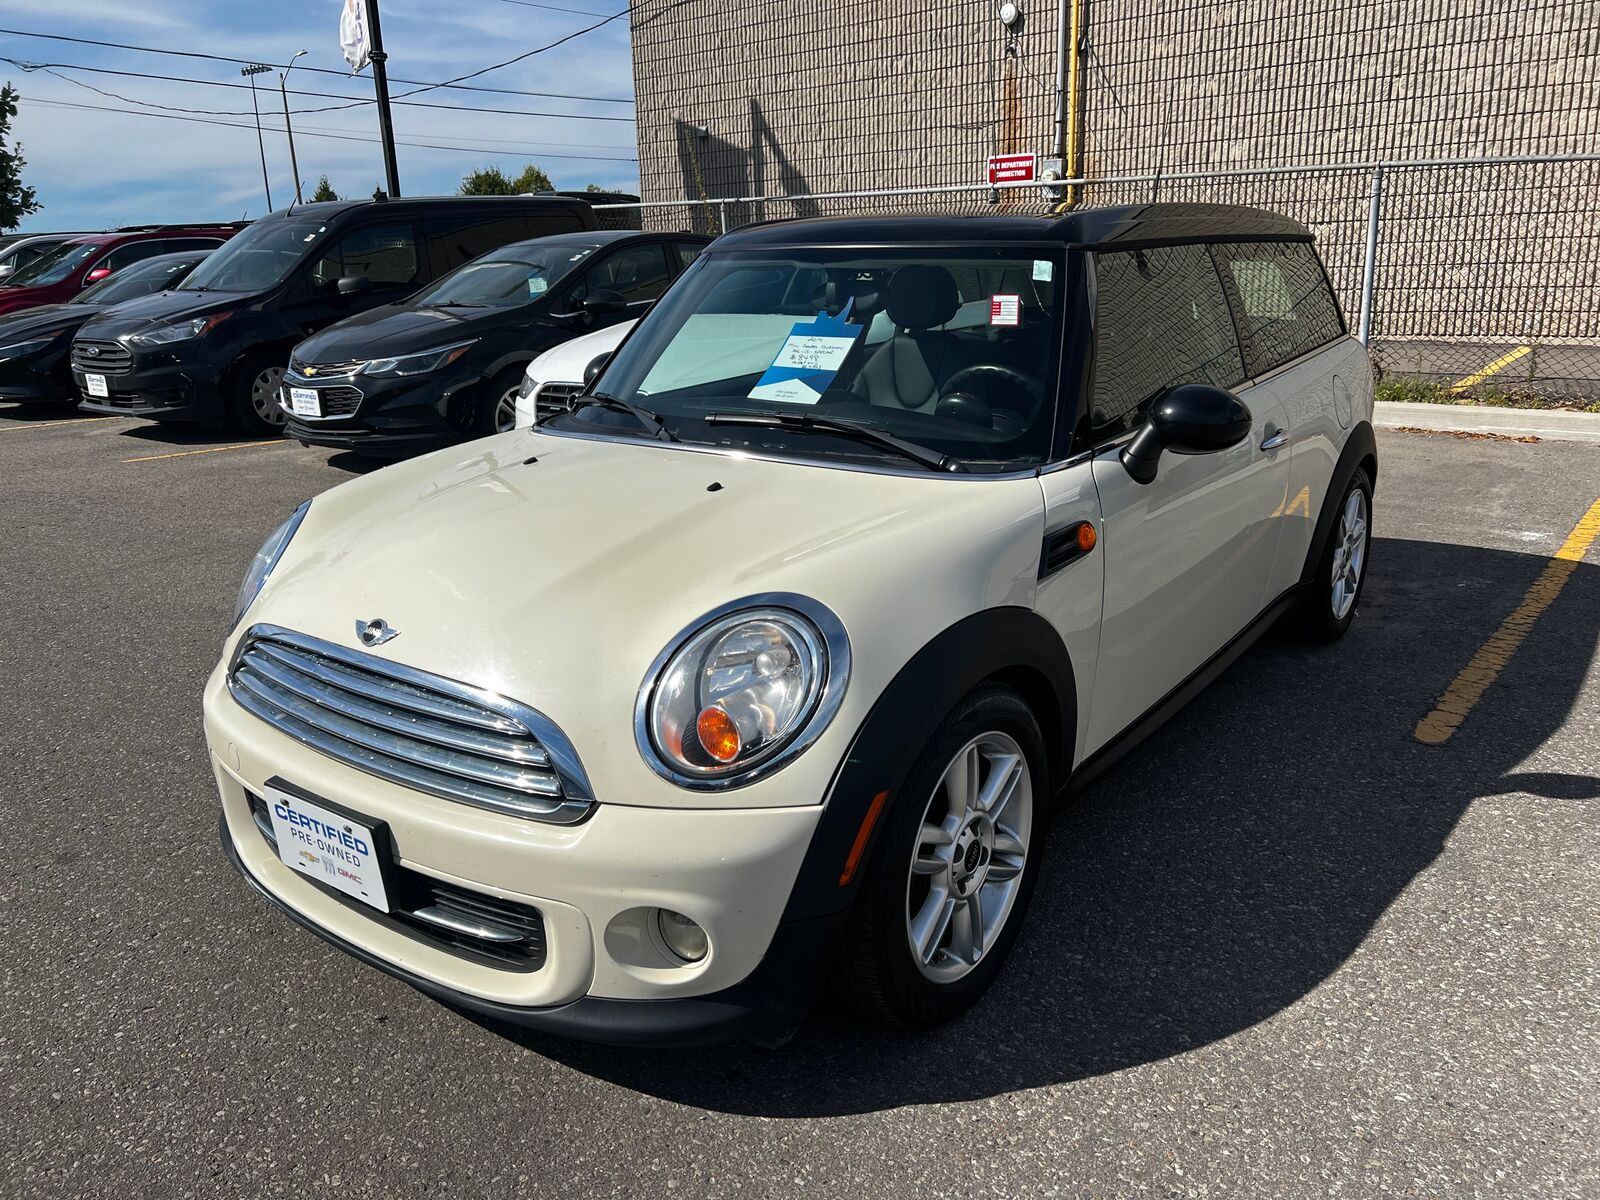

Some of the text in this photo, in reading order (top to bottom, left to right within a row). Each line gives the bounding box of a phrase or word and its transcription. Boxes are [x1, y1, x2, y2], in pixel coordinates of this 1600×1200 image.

[1001, 160, 1033, 169] DEPARTMENT
[274, 804, 369, 856] CERTIFIED
[290, 827, 361, 868] PRE-OWNED
[967, 844, 979, 869] MINI
[337, 867, 363, 885] GMC
